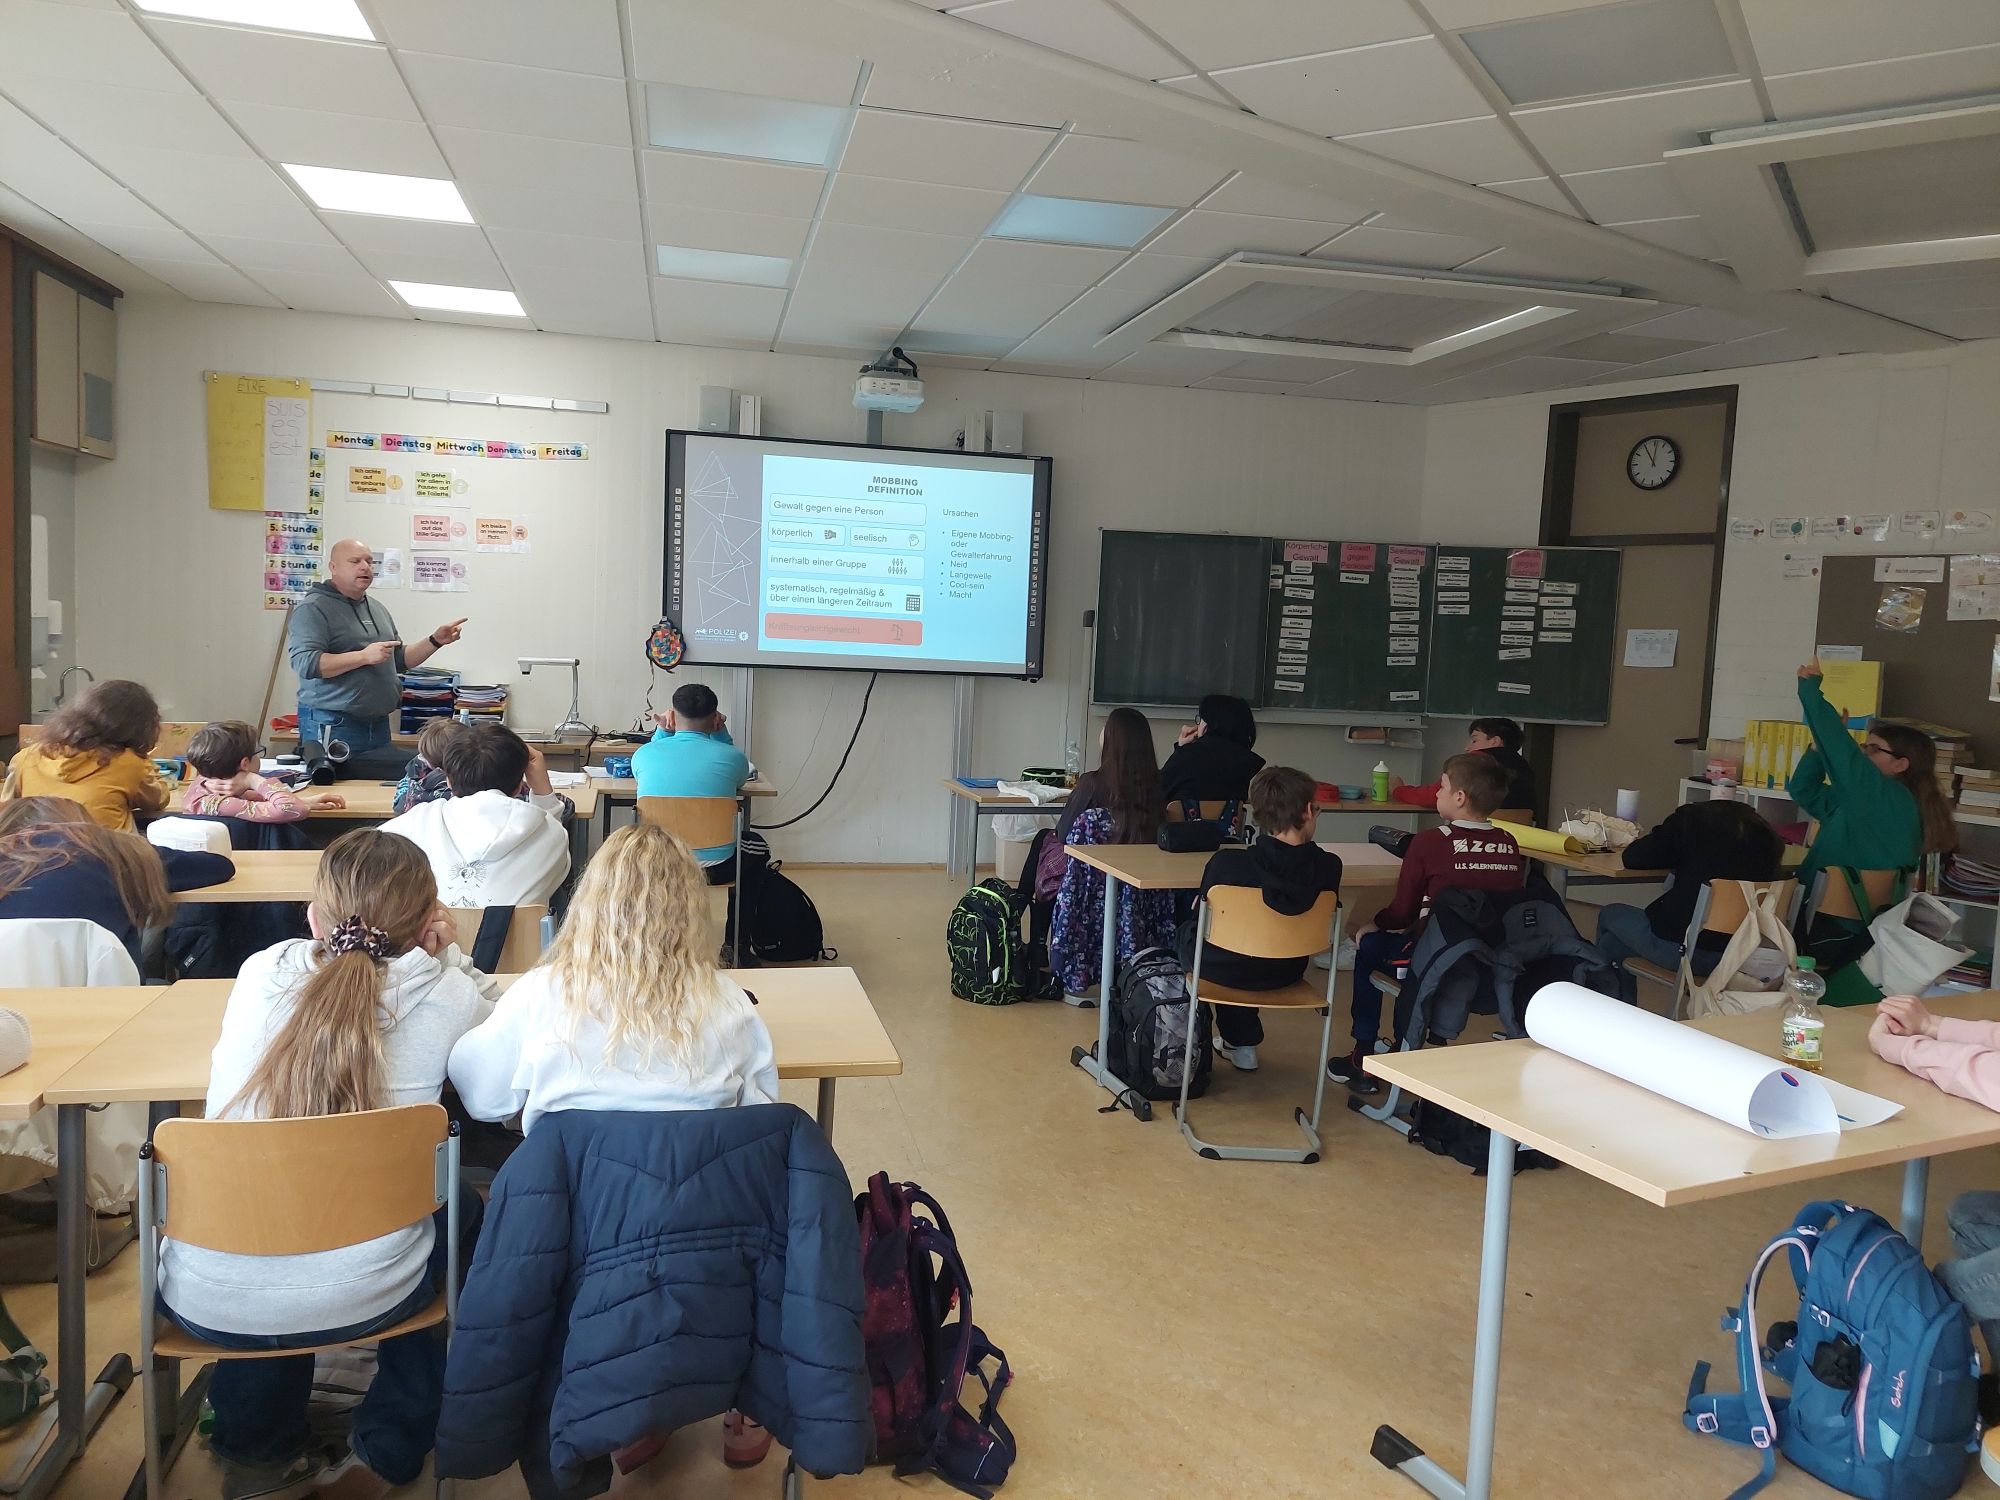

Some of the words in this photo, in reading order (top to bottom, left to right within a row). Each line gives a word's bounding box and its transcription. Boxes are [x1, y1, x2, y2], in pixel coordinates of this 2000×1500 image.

[334, 434, 374, 447] Montag
[385, 437, 432, 451] Dienstag
[436, 441, 484, 453] Mittwoch
[487, 445, 537, 457] Donnerstag
[546, 447, 582, 459] Freitag
[872, 476, 919, 487] MOBBING
[867, 485, 923, 496] DEFINITION
[773, 501, 803, 511] Gewalt
[805, 504, 832, 514] gegen
[834, 505, 852, 514] eine
[854, 506, 884, 516] Person
[942, 508, 979, 518] Ursachen
[269, 523, 278, 532] 5.
[281, 521, 318, 533] Stunde
[771, 528, 813, 538] körperlich
[853, 534, 887, 543] seelisch
[951, 529, 977, 538] Eigene
[979, 531, 1014, 542] Mobbing-
[282, 540, 319, 551] Stunde
[1285, 542, 1328, 551] Körperliche
[950, 550, 1012, 562] Gewalterfahrung
[1292, 553, 1319, 562] Gewalt
[1393, 557, 1420, 565] Gewalt
[281, 559, 318, 570] Stunde
[770, 554, 810, 565] innerhalb
[812, 558, 834, 567] einer
[836, 560, 867, 570] Gruppe
[950, 560, 968, 568] Neid
[949, 571, 992, 580] Langeweile
[770, 583, 828, 594] systematisch,
[830, 587, 876, 598] regelmäßig
[878, 589, 885, 597] &
[949, 580, 985, 590] Cool-sein
[770, 593, 789, 602] über
[791, 595, 815, 604] einen
[817, 597, 853, 607] längeren
[856, 598, 893, 608] Zeitraum
[949, 591, 972, 599] Macht
[268, 597, 278, 605] 9.
[708, 628, 737, 636] POLIZEI
[1470, 840, 1514, 855] Zeus
[1454, 862, 1468, 870] U.S.
[1468, 863, 1508, 871] SALERNITANA
